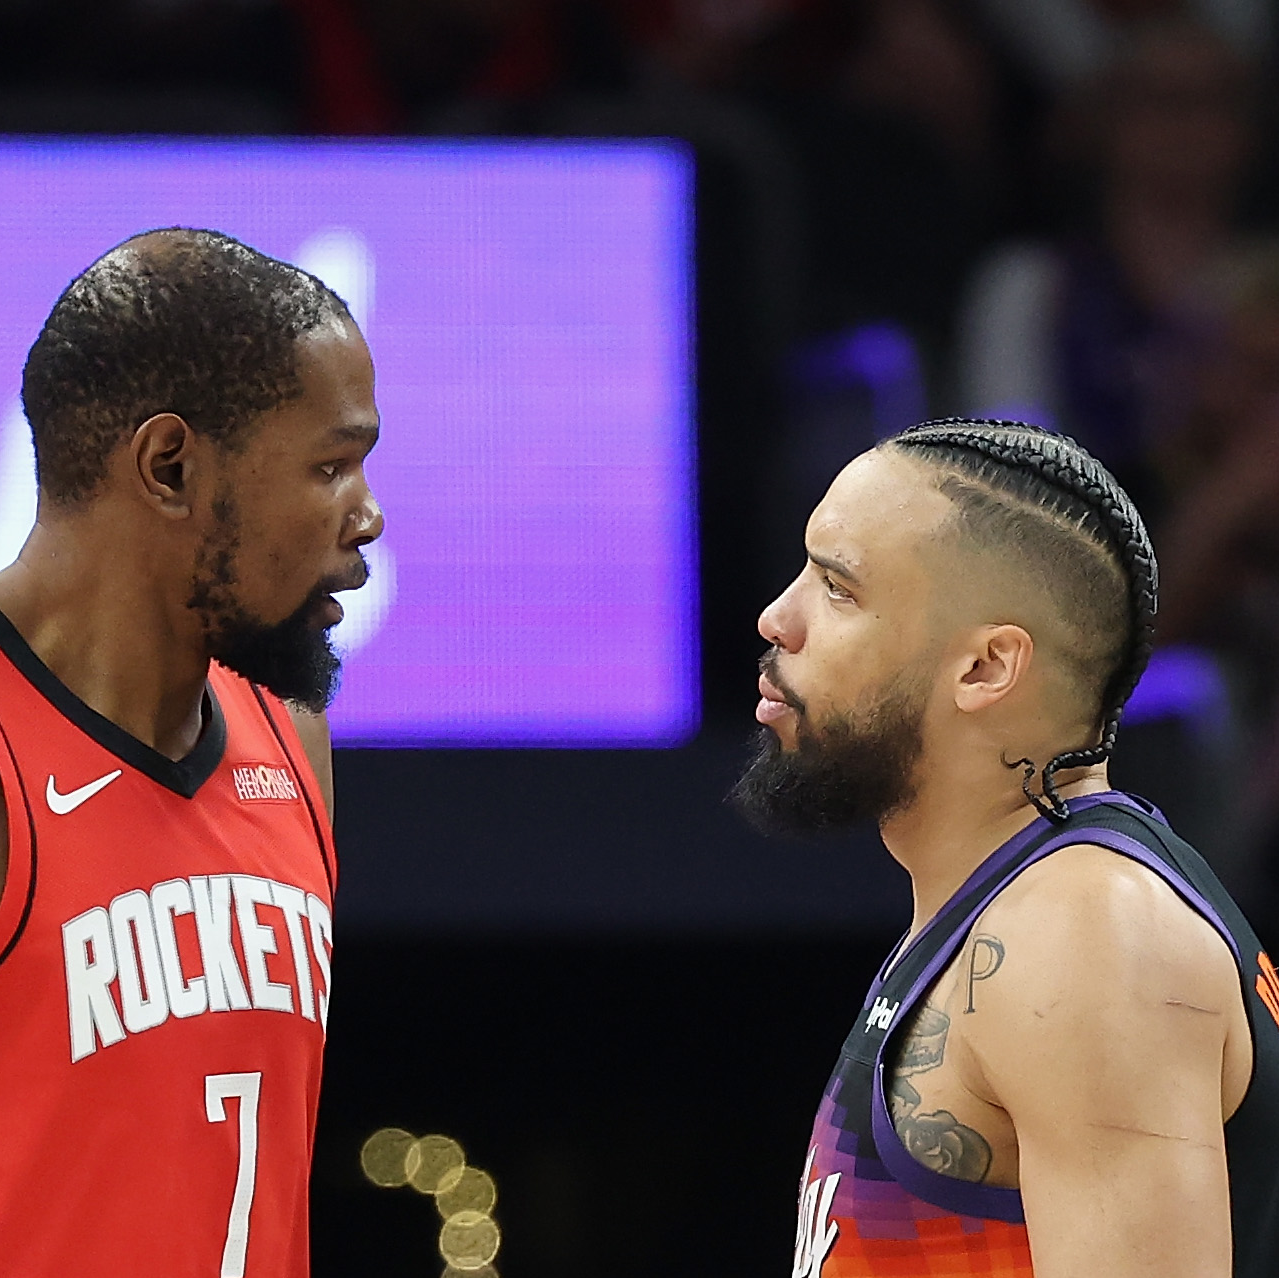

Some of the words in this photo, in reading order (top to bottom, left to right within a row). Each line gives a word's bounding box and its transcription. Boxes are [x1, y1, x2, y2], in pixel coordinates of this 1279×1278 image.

[232, 764, 294, 788] MEMORIAL
[236, 781, 298, 800] HERMANN
[60, 874, 333, 1064] ROCKETS
